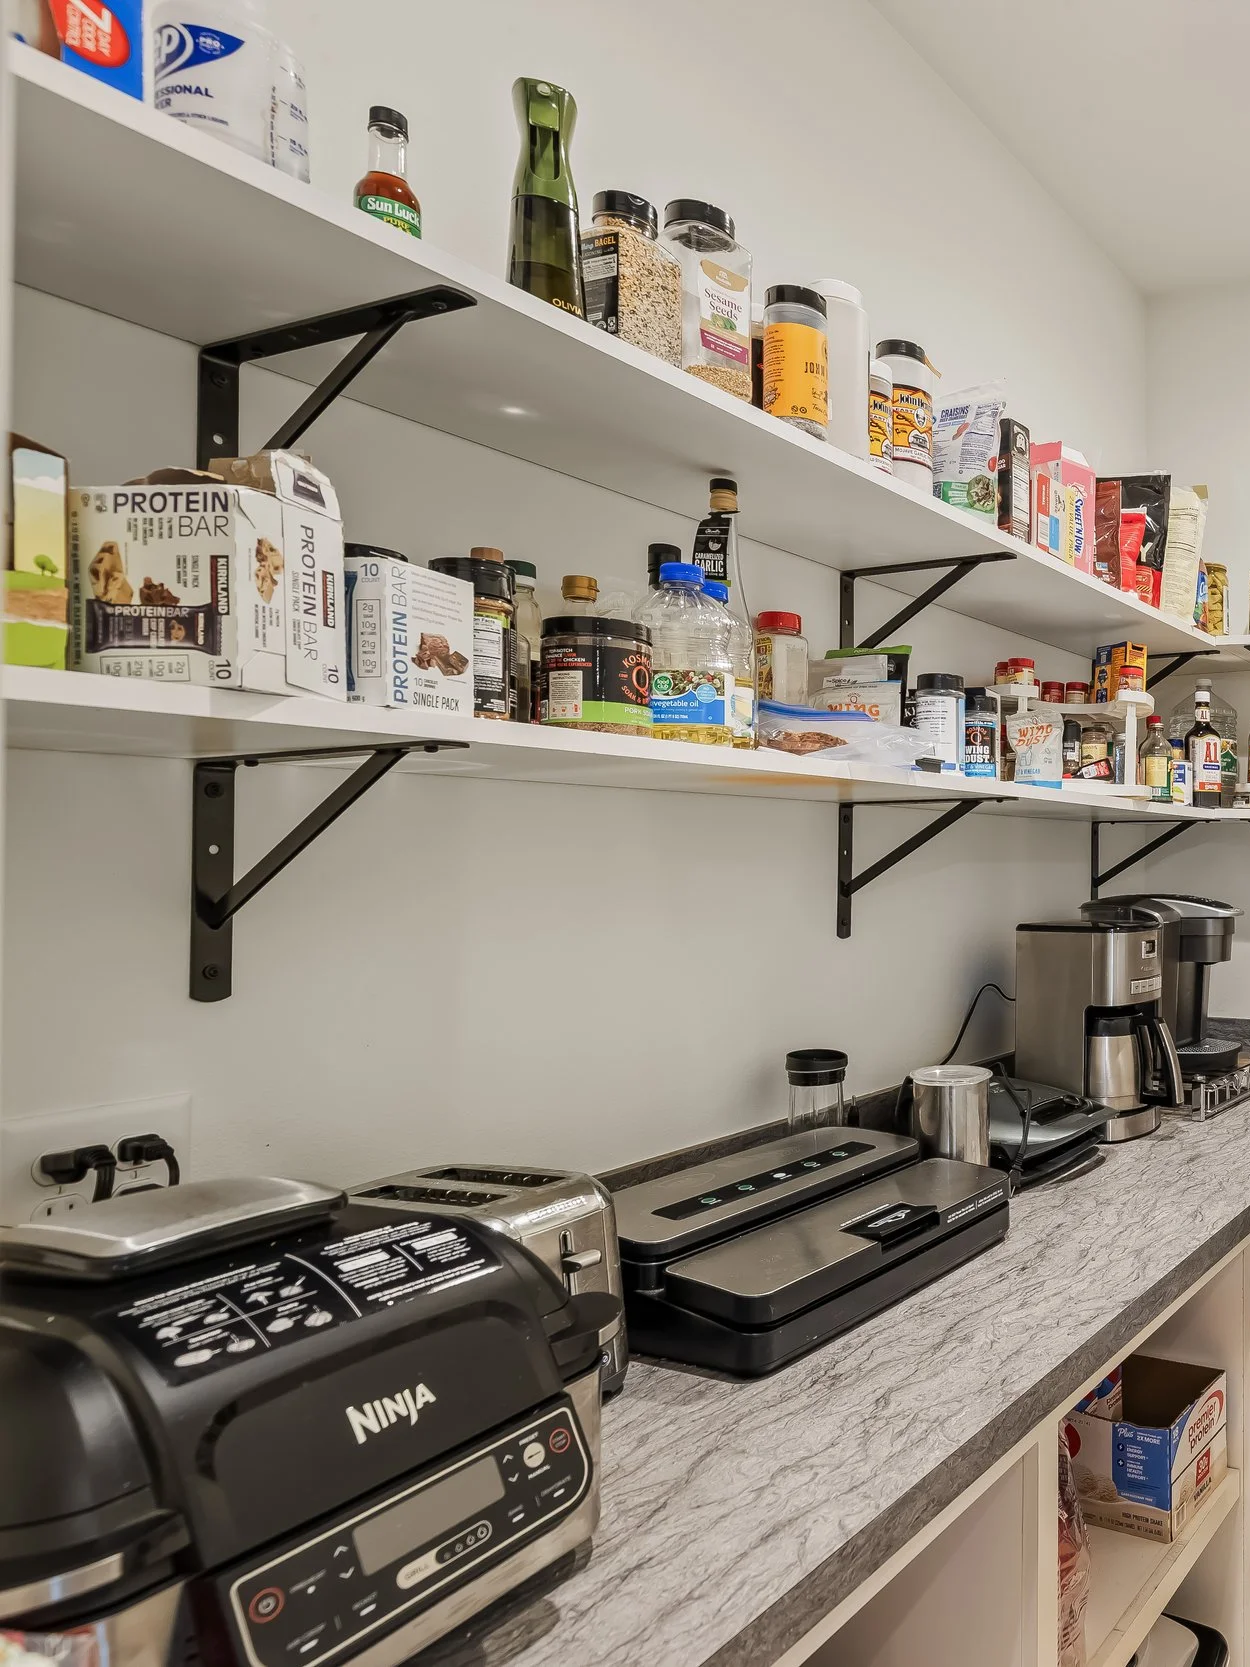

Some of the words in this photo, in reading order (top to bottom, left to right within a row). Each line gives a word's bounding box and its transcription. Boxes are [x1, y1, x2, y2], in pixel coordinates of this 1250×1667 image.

[367, 197, 393, 214] Sun
[394, 203, 421, 228] Luck
[594, 235, 616, 249] BAGEL
[704, 287, 743, 313] Sesame
[709, 300, 739, 322] Seeds
[940, 406, 970, 419] CRAISINS
[113, 491, 229, 514] PROTEIN
[178, 515, 230, 537] BAR
[694, 552, 725, 561] CARAMELIZED
[300, 524, 318, 616] PROTEIN
[360, 563, 379, 577] 10
[217, 557, 229, 614] KIRKLAND
[391, 566, 407, 608] BAR
[326, 573, 336, 627] KIRKLAND
[114, 605, 166, 618] PROTEIN
[362, 603, 374, 613] 2g
[361, 621, 377, 631] 10g
[303, 620, 319, 661] BAR
[361, 640, 376, 650] 21g
[362, 659, 377, 669] 10g
[392, 610, 409, 704] PROTEIN
[215, 658, 232, 680] 10
[327, 663, 339, 684] 10
[413, 677, 424, 687] 10
[412, 691, 439, 710] SINGLE
[440, 696, 460, 712] PACK
[653, 699, 689, 709] vegetable
[689, 699, 699, 707] oil
[1017, 723, 1054, 738] WING
[1015, 734, 1050, 747] DUST
[965, 745, 990, 755] WING
[965, 754, 990, 763] DUST
[345, 1383, 437, 1445] NINJA
[1188, 1400, 1217, 1443] premier
[1117, 1427, 1135, 1439] Plus
[1171, 1426, 1180, 1438] 18
[1189, 1417, 1216, 1454] protein
[1143, 1437, 1161, 1445] MORE
[1126, 1447, 1143, 1455] ENERGY
[1126, 1463, 1144, 1471] IMMUNE
[1193, 1476, 1213, 1502] VANILLA
[1121, 1511, 1132, 1519] HIGH
[1131, 1513, 1149, 1523] PROTEIN
[1149, 1517, 1164, 1527] SHAKE
